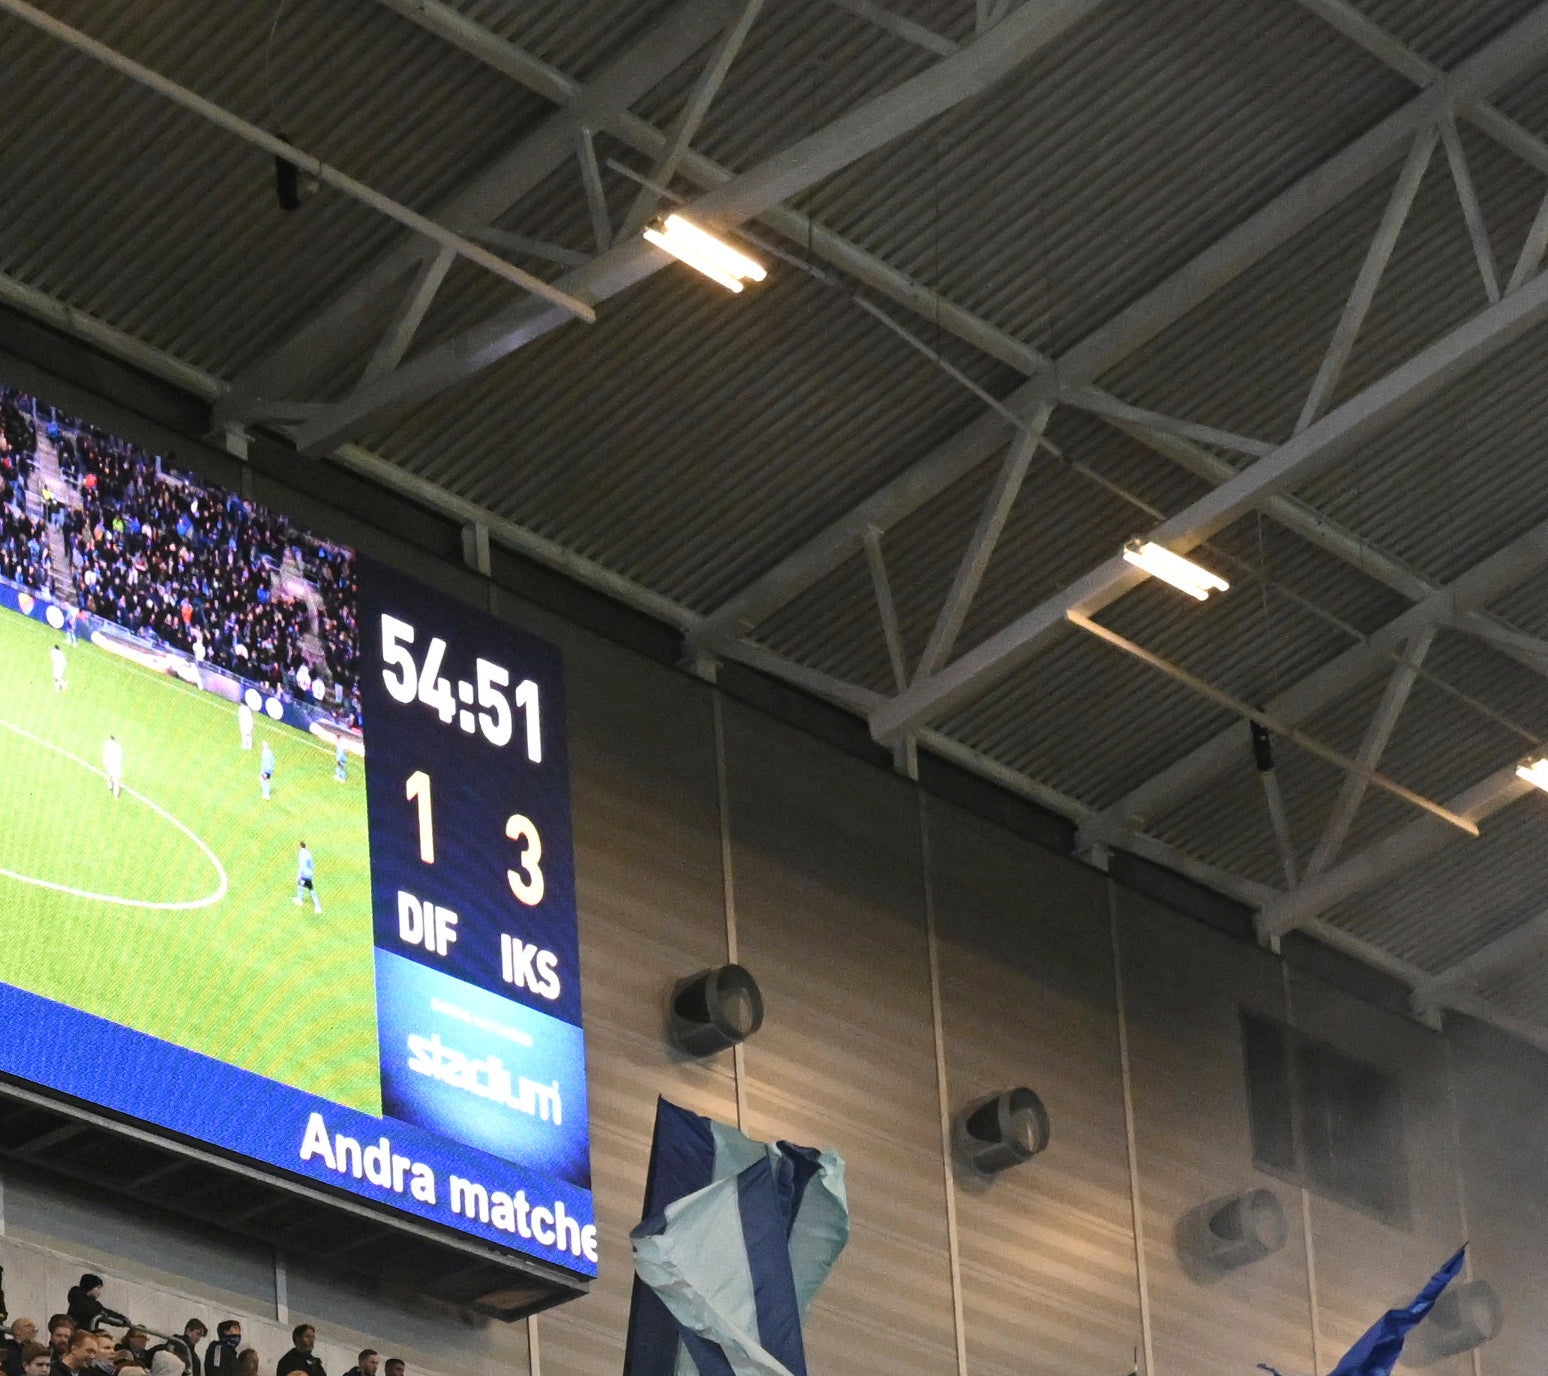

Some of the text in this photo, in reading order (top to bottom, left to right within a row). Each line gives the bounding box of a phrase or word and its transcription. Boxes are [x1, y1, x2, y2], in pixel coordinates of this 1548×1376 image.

[380, 612, 542, 764] 54:51
[405, 770, 545, 906] 1 3
[397, 890, 561, 1001] DIF IKS
[405, 1031, 563, 1127] stadium
[300, 1110, 437, 1208] Andra
